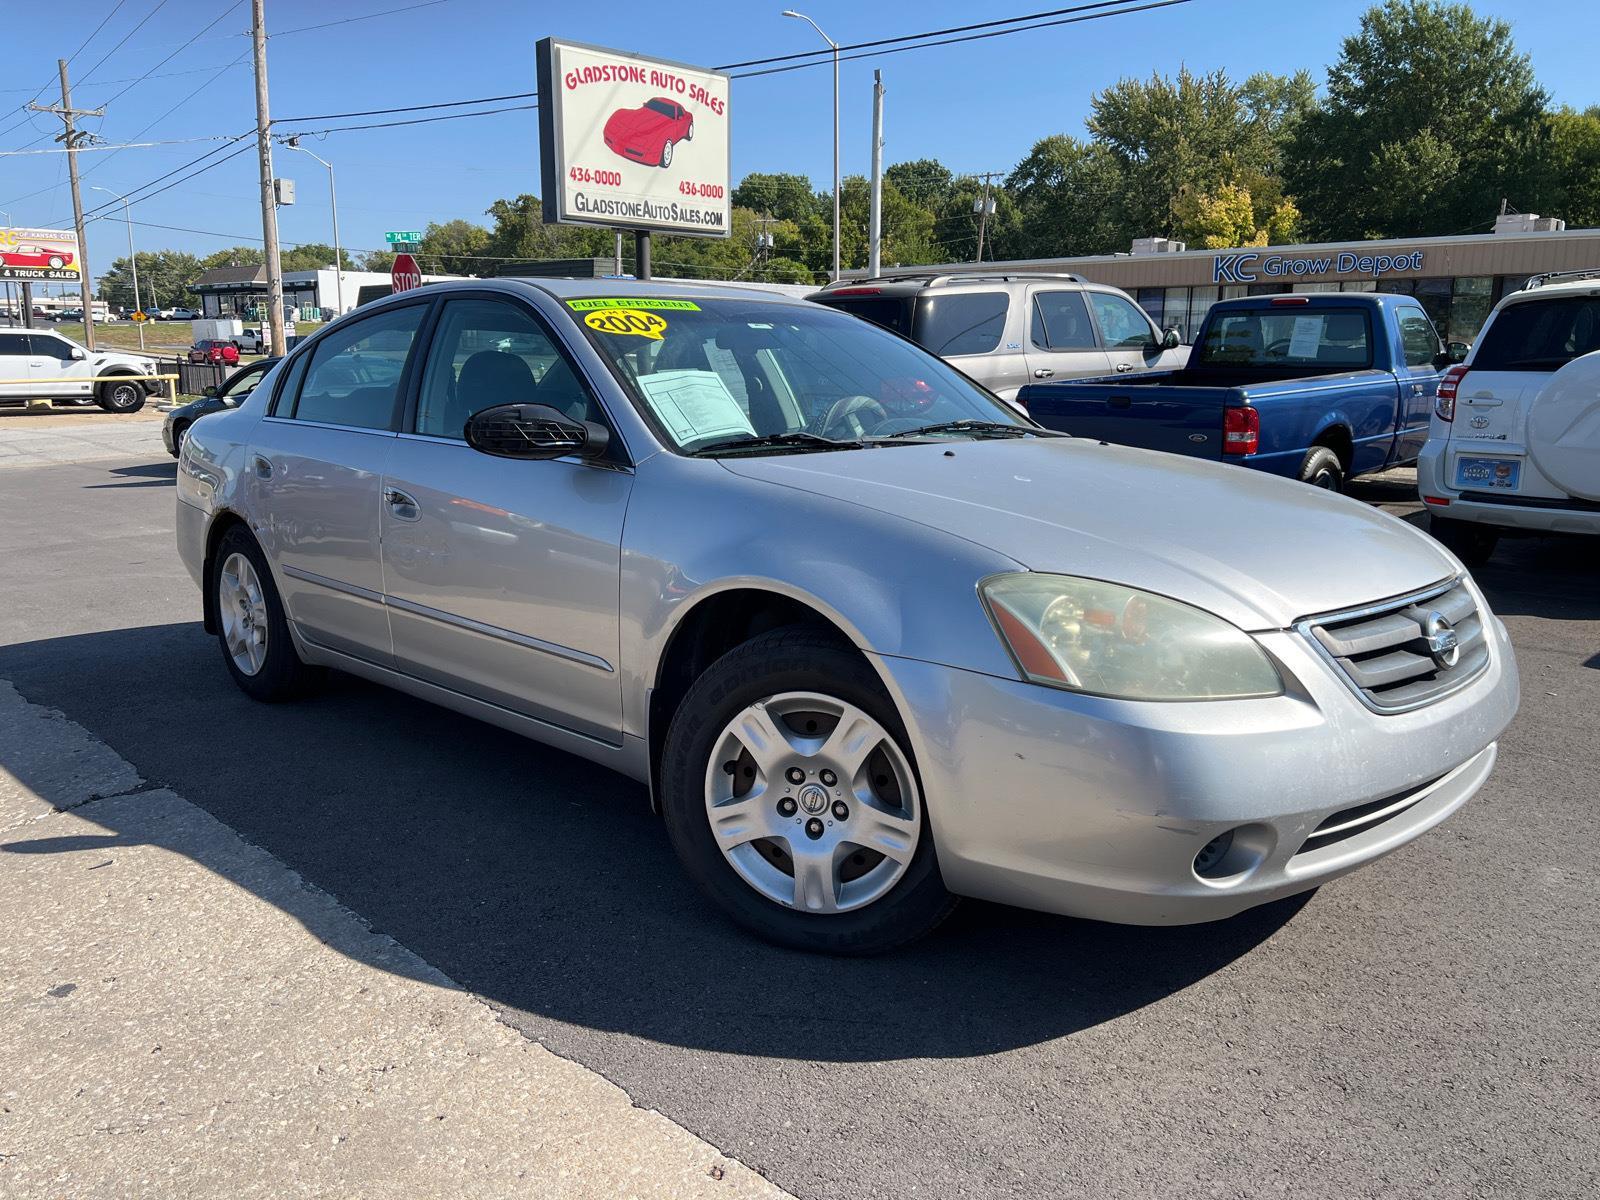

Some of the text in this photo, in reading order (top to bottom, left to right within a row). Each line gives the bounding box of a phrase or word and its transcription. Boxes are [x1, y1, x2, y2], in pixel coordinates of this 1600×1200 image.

[565, 64, 725, 116] GLADSTONE AUTO SALES
[569, 166, 621, 187] 436-0000
[679, 180, 724, 199] 436-0000
[409, 232, 421, 240] TER
[1213, 251, 1424, 283] KC Grow Depot
[393, 272, 419, 294] STOP
[572, 300, 692, 309] FUEL EFFICIENT
[589, 315, 662, 332] 2004
